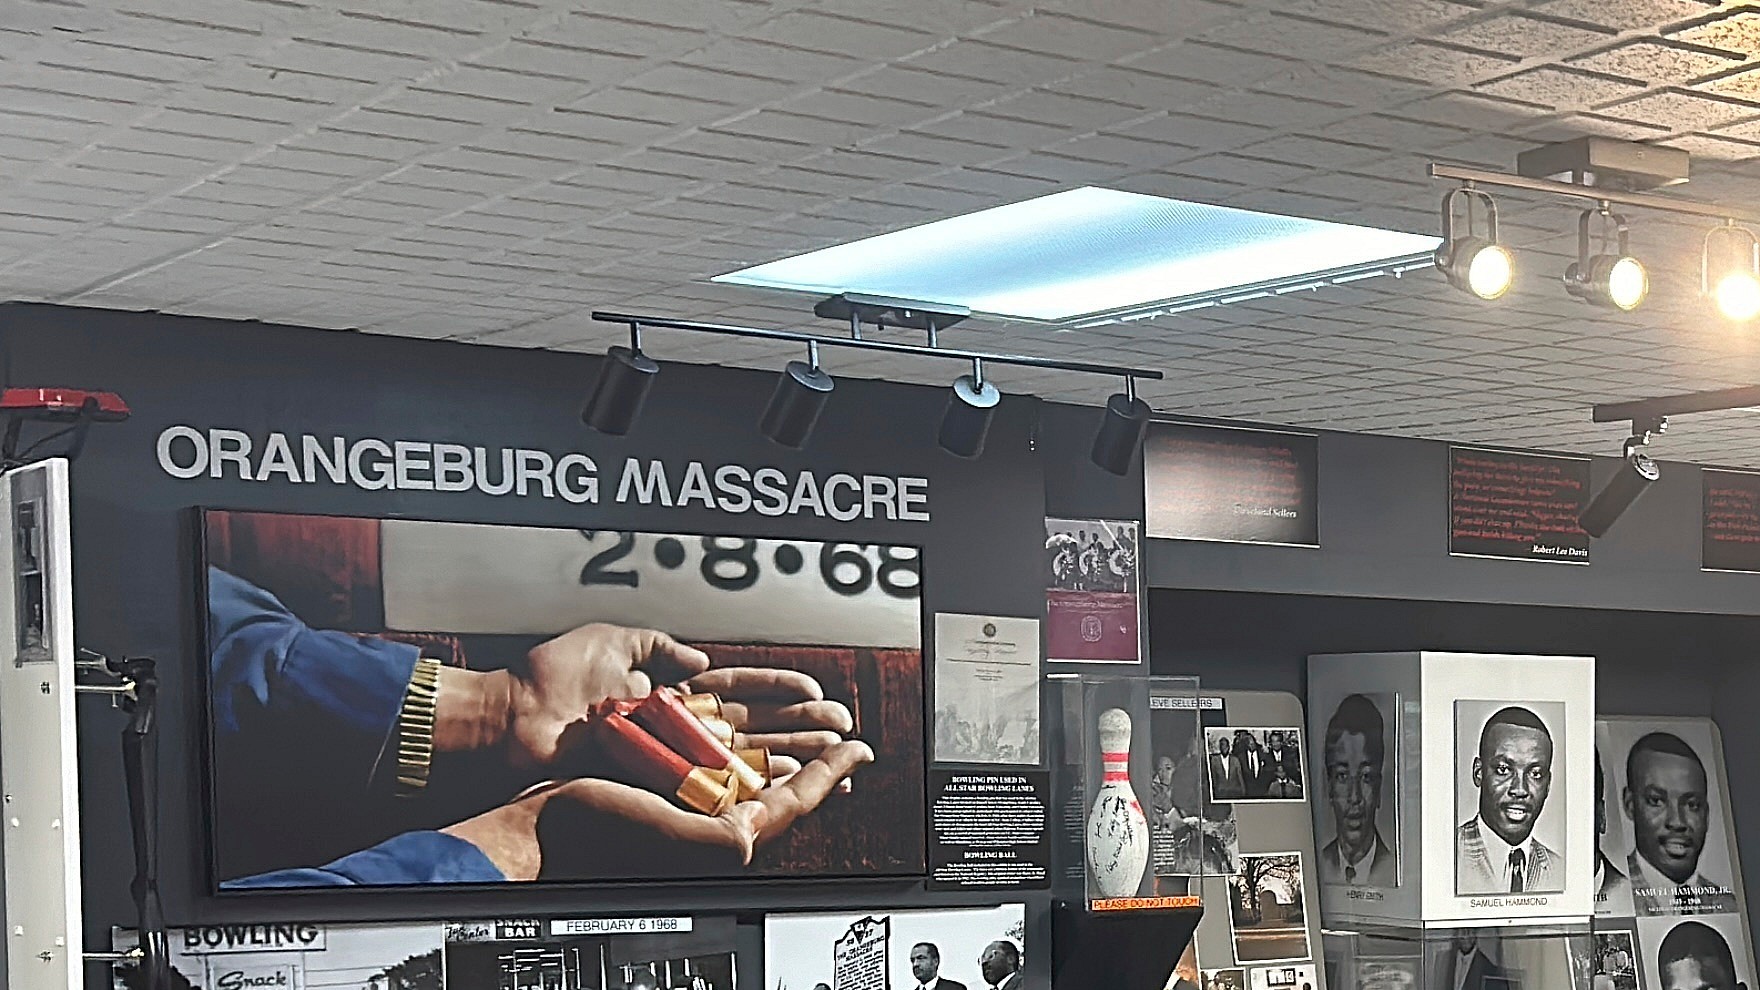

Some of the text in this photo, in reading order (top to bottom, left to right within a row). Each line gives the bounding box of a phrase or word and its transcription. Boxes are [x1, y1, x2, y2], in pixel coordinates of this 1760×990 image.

[156, 425, 931, 523] ORANGEBURG MASSACRE
[1094, 900, 1128, 909] PLEASE
[1470, 897, 1548, 908] SAMUEL HAMMOND
[567, 919, 678, 932] FEBRUARY 6 1968
[184, 924, 318, 948] BOWLING
[505, 928, 536, 937] BAR
